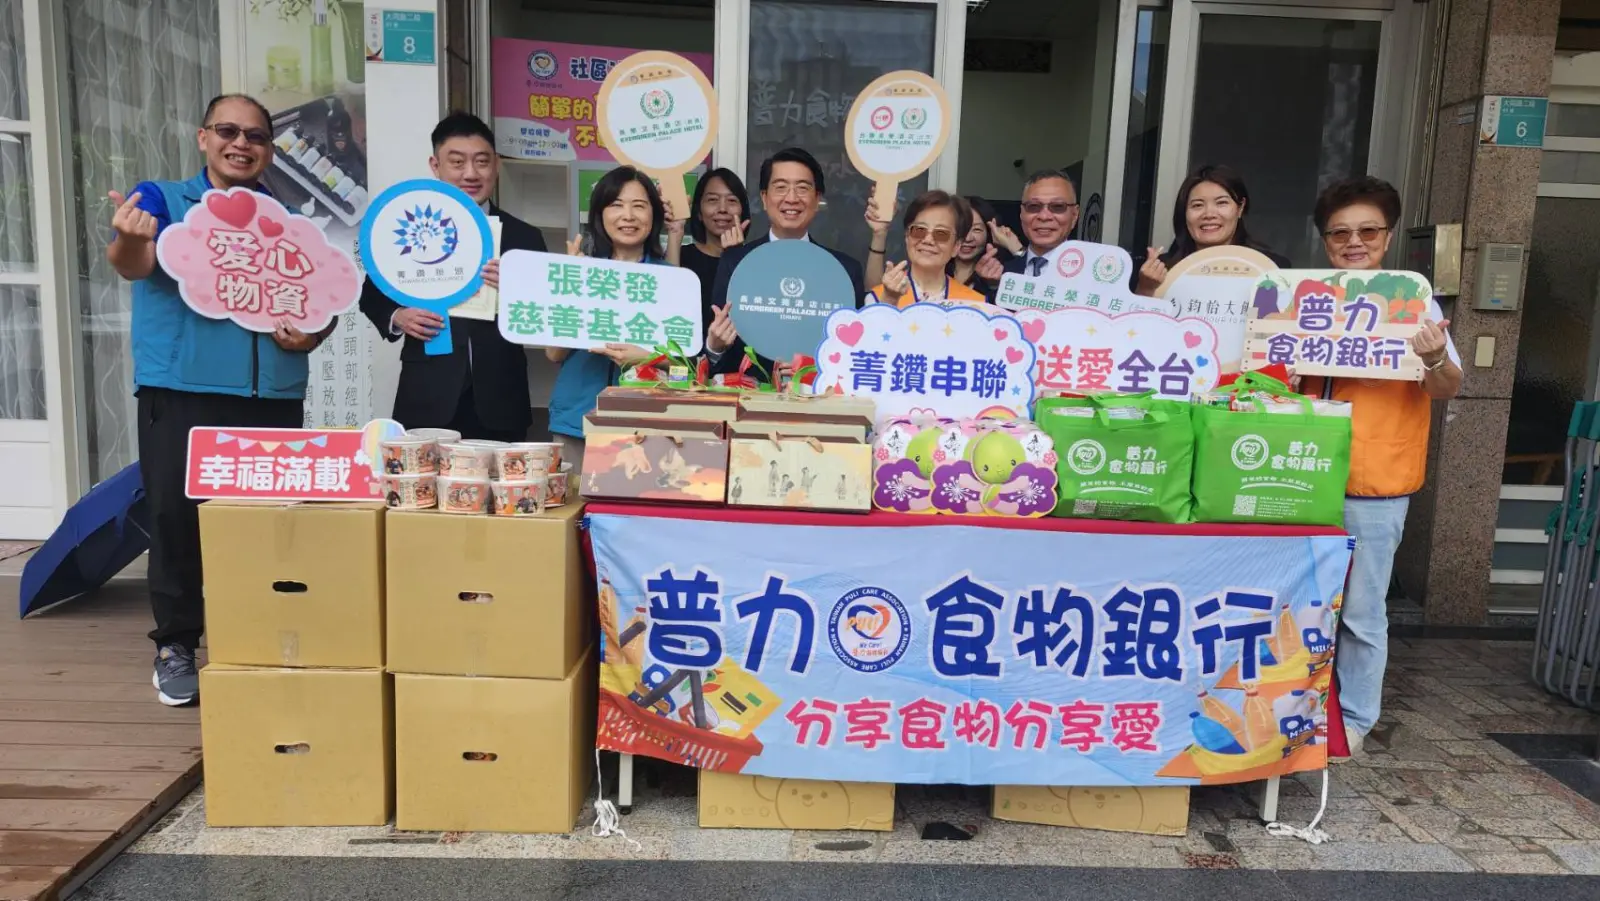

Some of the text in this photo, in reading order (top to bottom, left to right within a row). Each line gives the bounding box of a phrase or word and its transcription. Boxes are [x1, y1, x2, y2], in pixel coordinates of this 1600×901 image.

[404, 36, 415, 54] 8
[569, 57, 616, 82] 社區
[529, 94, 599, 121] 簡單的
[1516, 121, 1527, 138] 6
[207, 229, 314, 279] 愛心
[217, 273, 308, 319] 物資
[548, 263, 658, 304] 張榮發
[508, 301, 695, 347] 慈善基金會
[739, 304, 785, 314] EVERGREEN
[786, 307, 817, 316] PALACE
[1299, 295, 1379, 332] 普力
[1267, 333, 1406, 370] 食物銀行
[850, 350, 1008, 399] 菁鑽串聯
[1036, 345, 1194, 396] 送愛全台
[1126, 445, 1157, 460] 普力
[1271, 454, 1333, 472] 食物銀行
[1288, 441, 1319, 456] 普力
[198, 454, 351, 492] 幸福滿載
[1109, 459, 1168, 475] 食物銀行
[646, 568, 1275, 683] 普力 食物銀行
[831, 602, 844, 625] TAIWAN
[844, 591, 859, 602] PULI
[881, 591, 909, 625] ASSOCIATION
[830, 634, 858, 668] ASSOCIATION
[784, 696, 1161, 752] 分享食物分享愛
